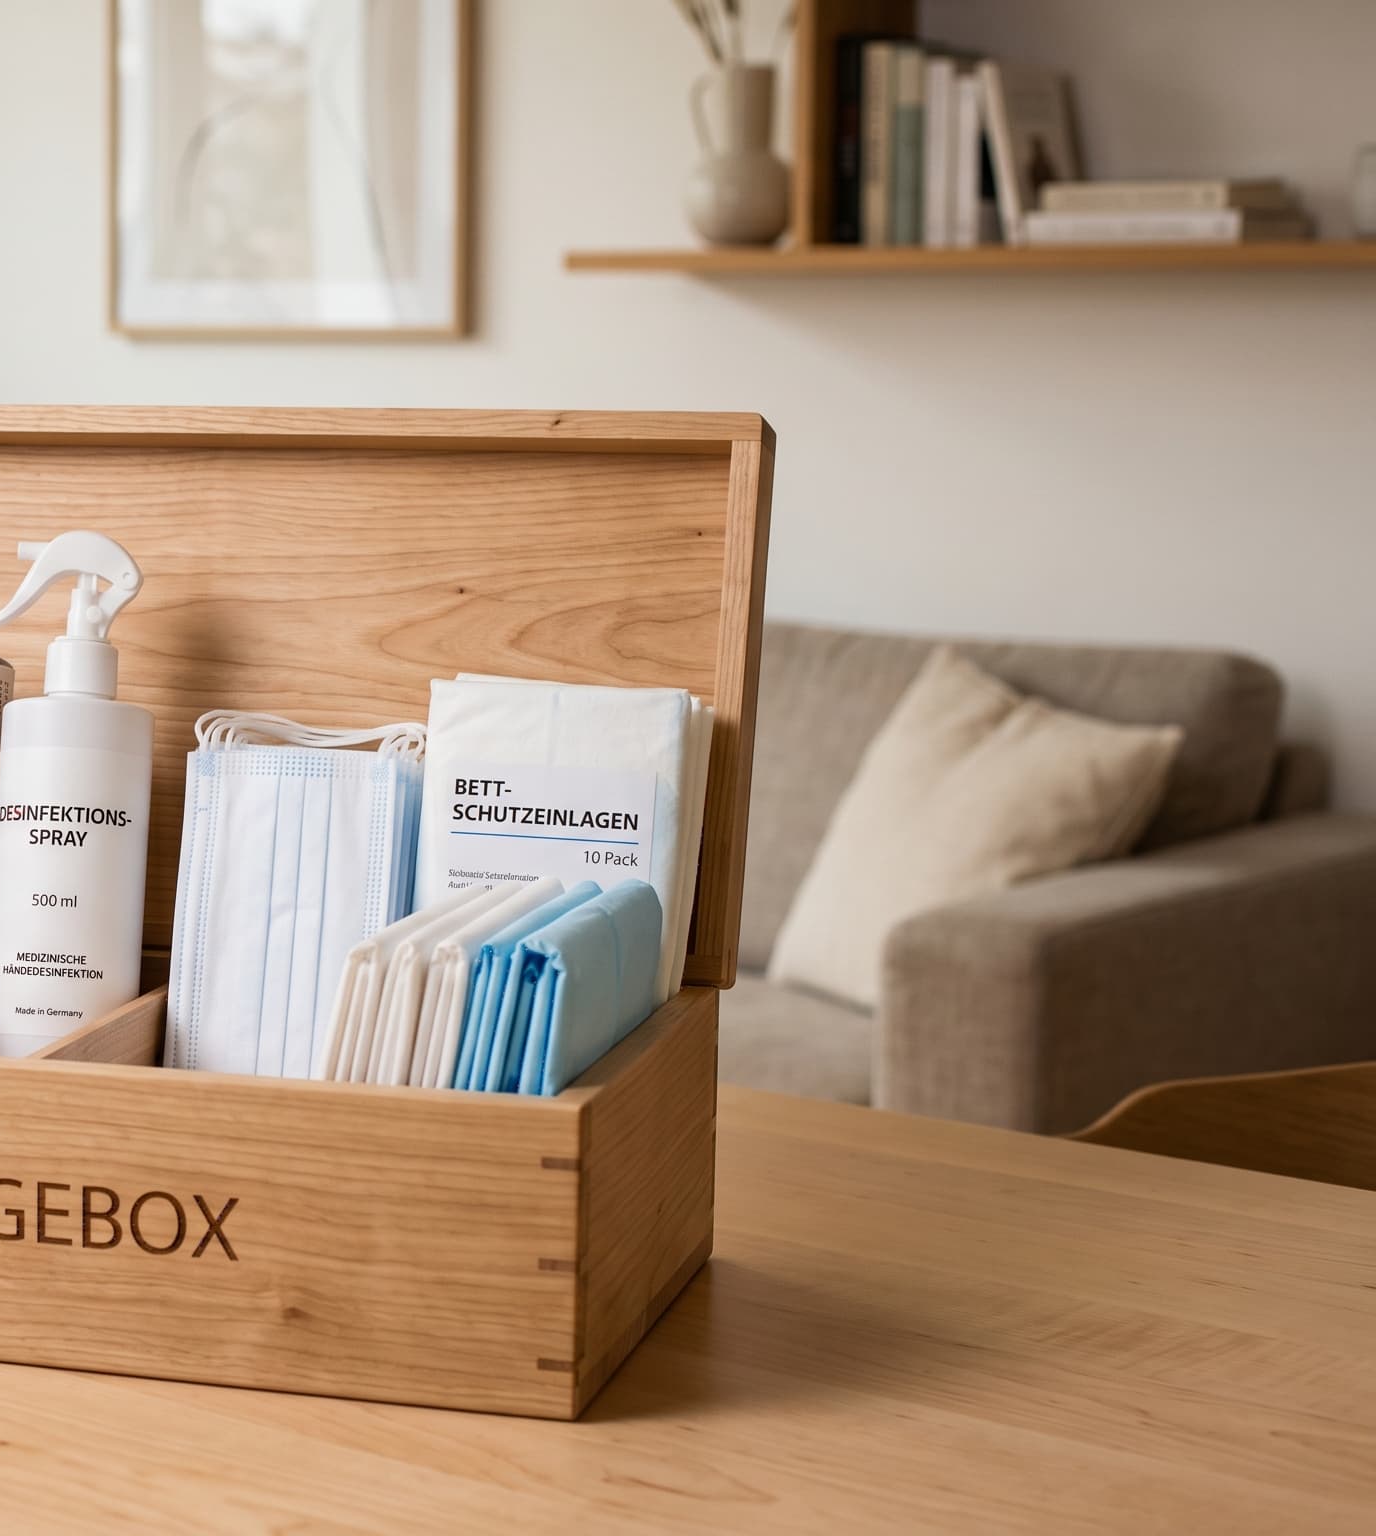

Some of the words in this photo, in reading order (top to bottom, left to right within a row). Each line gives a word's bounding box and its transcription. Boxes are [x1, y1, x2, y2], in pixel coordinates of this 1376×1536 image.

[454, 778, 512, 797] BETT-
[0, 805, 133, 827] DESINFEKTIONS-
[452, 803, 639, 831] SCHUTZEINLAGEN
[28, 828, 88, 847] SPRAY
[583, 850, 601, 865] 10
[604, 851, 639, 867] Pack
[31, 893, 58, 907] 500
[60, 894, 78, 908] ml
[16, 952, 88, 965] MEDIZINISCHE
[15, 1006, 36, 1015] Made
[37, 1007, 45, 1015] in
[46, 1008, 84, 1019] Germany
